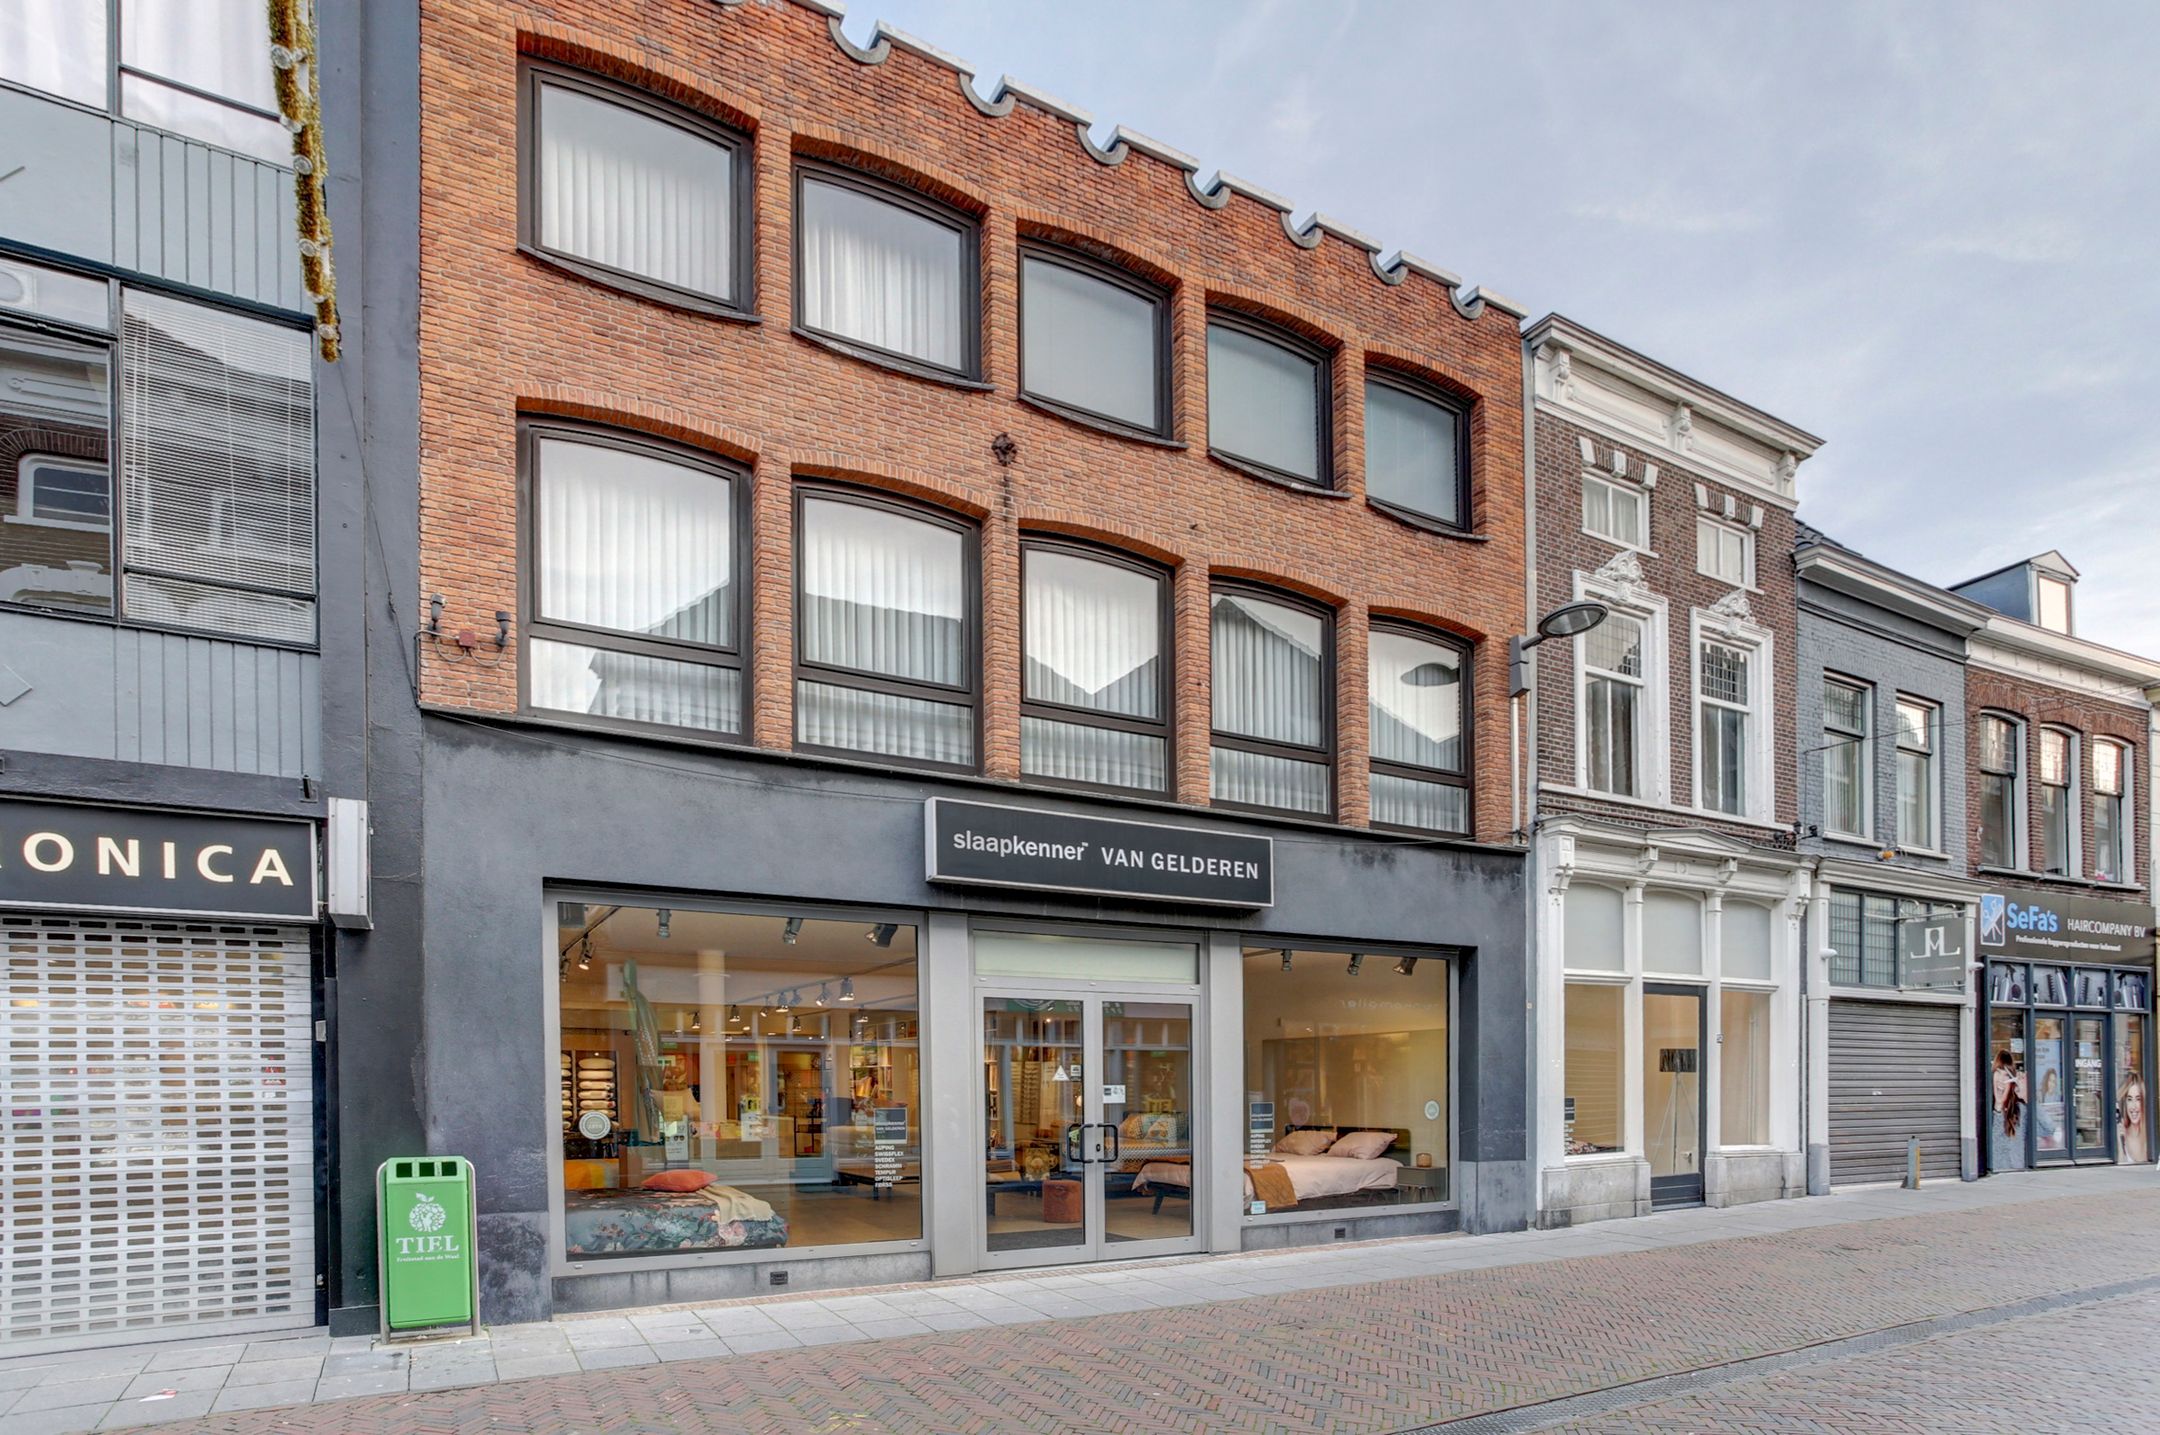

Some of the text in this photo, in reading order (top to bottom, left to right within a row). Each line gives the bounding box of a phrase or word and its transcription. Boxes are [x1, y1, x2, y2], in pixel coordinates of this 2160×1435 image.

[0, 831, 294, 886] ONICA
[1101, 847, 1144, 868] VAN
[1151, 852, 1259, 880] GELDEREN
[2006, 902, 2058, 933] SeFa's
[2067, 918, 2147, 938] HAIRCOMPANY BV
[2074, 1059, 2102, 1068] INGANG
[396, 1235, 459, 1253] TIEL
